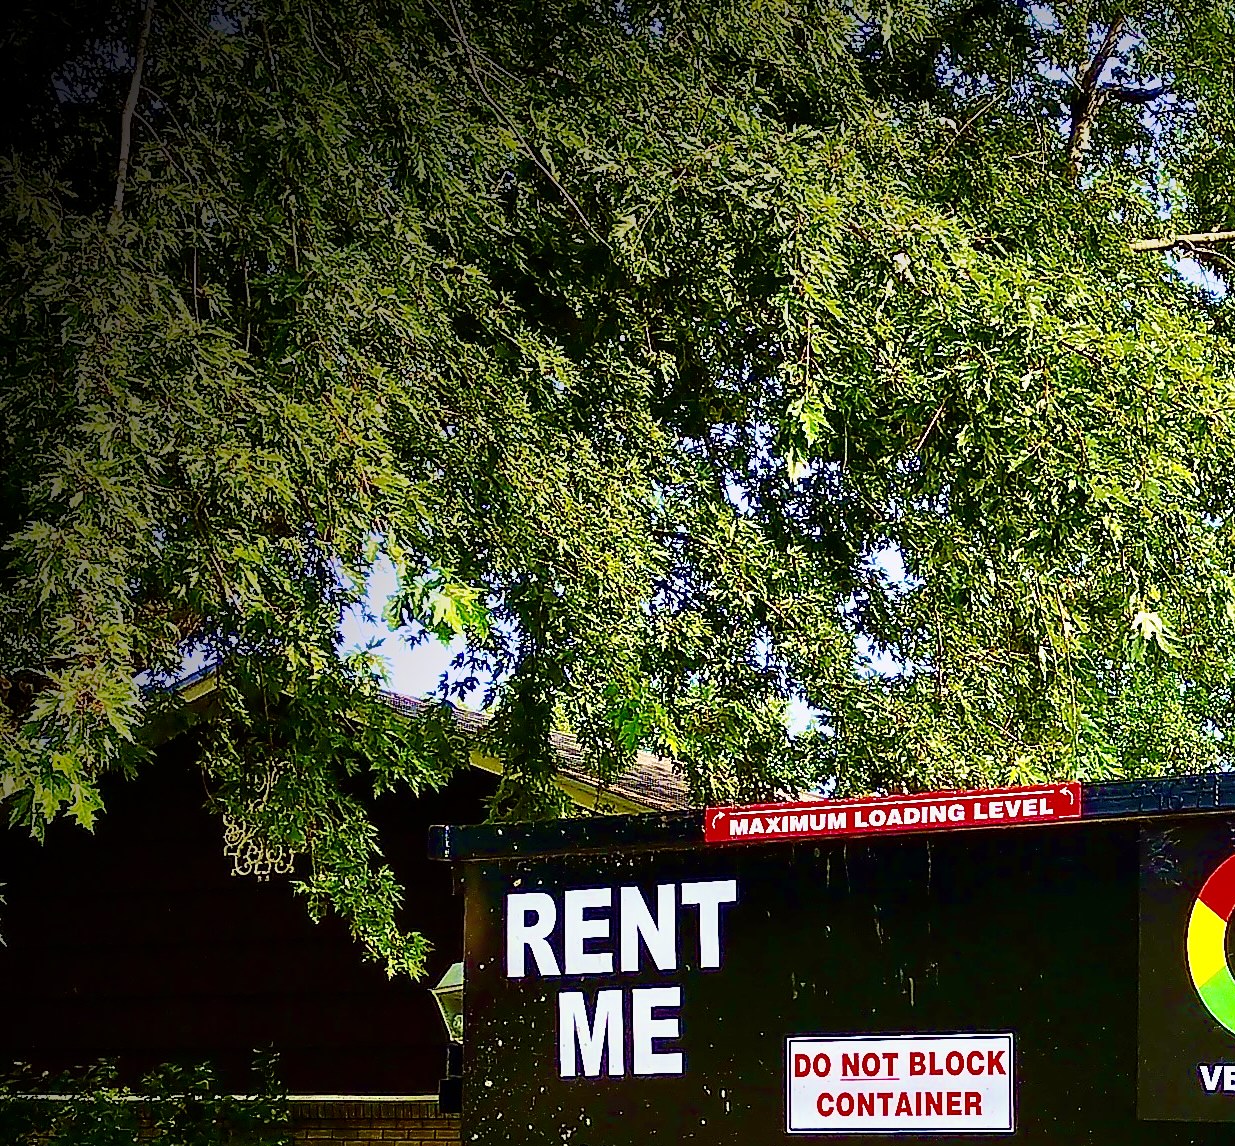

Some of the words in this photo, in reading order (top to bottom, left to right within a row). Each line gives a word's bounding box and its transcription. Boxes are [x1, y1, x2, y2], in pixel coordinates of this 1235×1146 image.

[729, 812, 846, 836] MAXIMUM
[852, 804, 966, 828] LOADING
[971, 795, 1054, 820] LEVEL
[507, 880, 737, 978] RENT
[558, 986, 684, 1078] ME
[794, 1053, 831, 1078] DO
[841, 1053, 899, 1078] NOT
[910, 1051, 1006, 1077] BLOCK
[816, 1091, 983, 1118] CONTAINER
